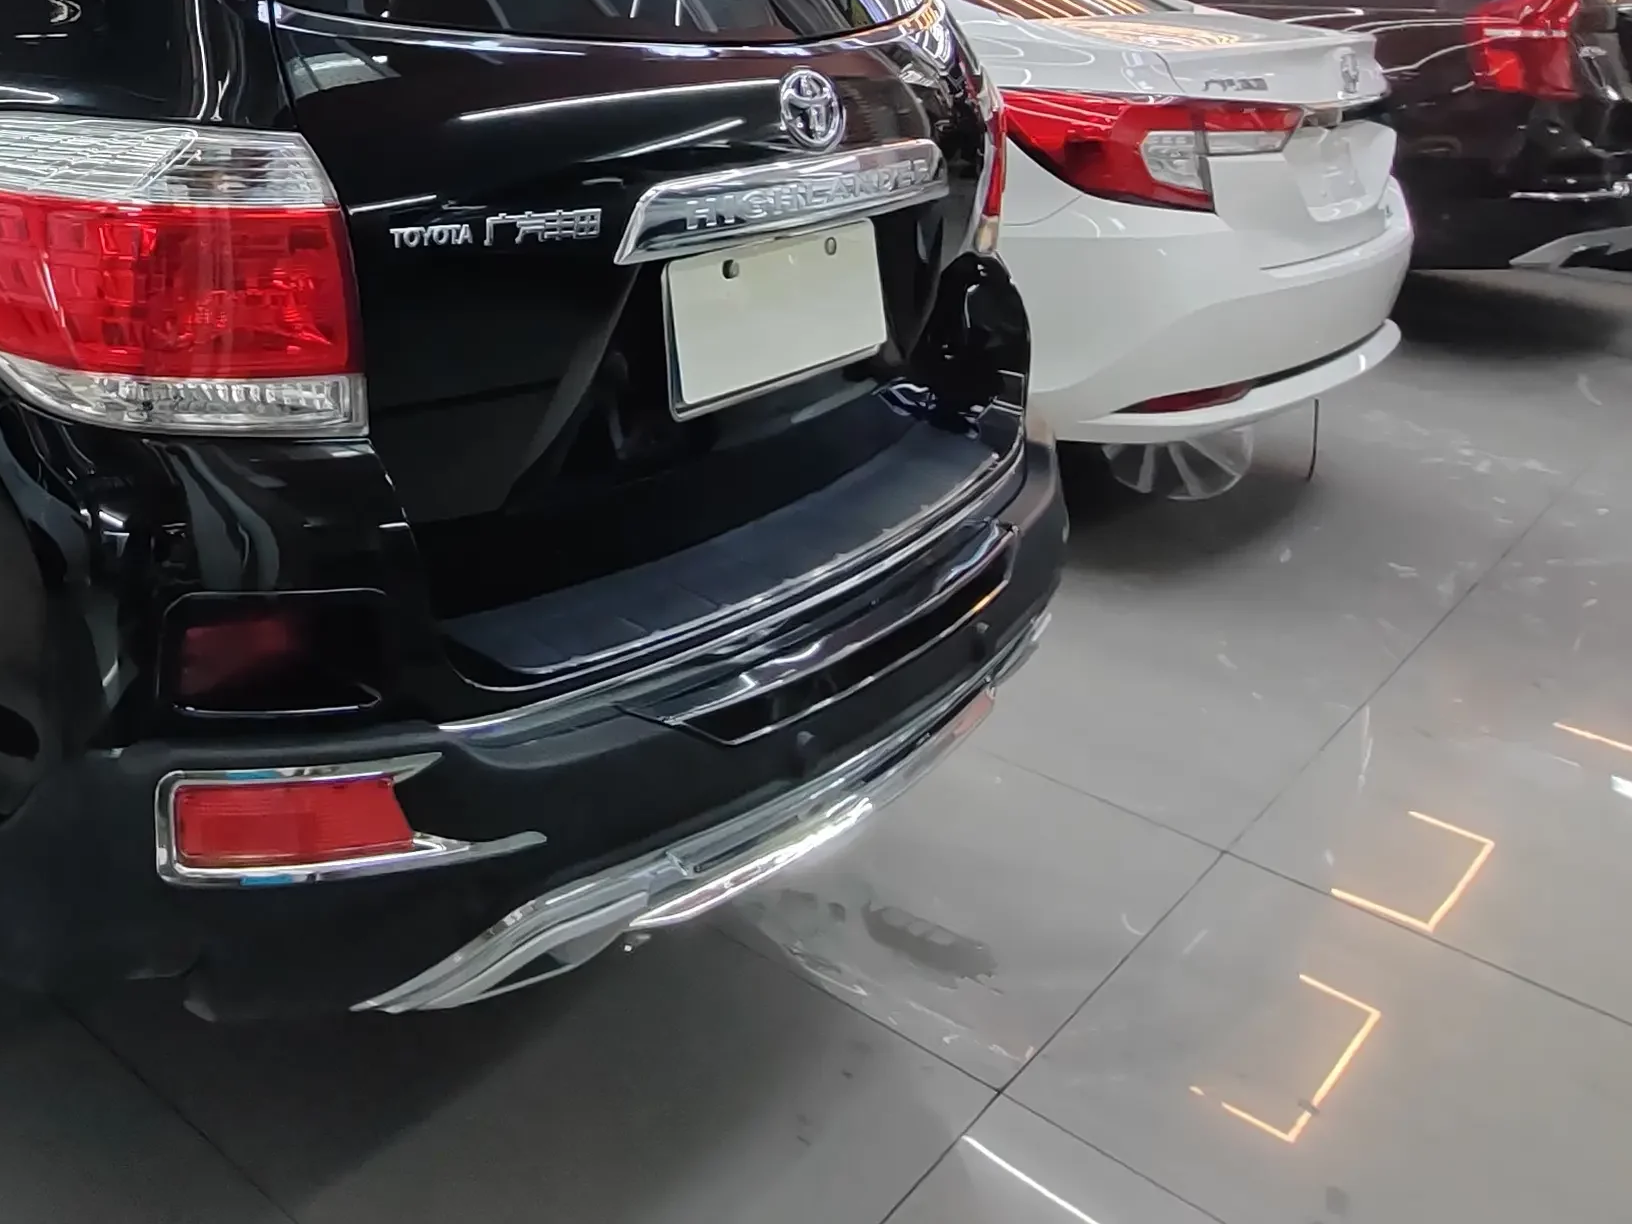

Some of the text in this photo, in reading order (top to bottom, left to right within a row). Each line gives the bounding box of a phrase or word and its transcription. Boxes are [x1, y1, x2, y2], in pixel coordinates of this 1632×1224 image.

[684, 158, 934, 230] HIGHLANDER
[389, 223, 474, 249] TOYOTA
[483, 208, 602, 246] 广汽丰田
